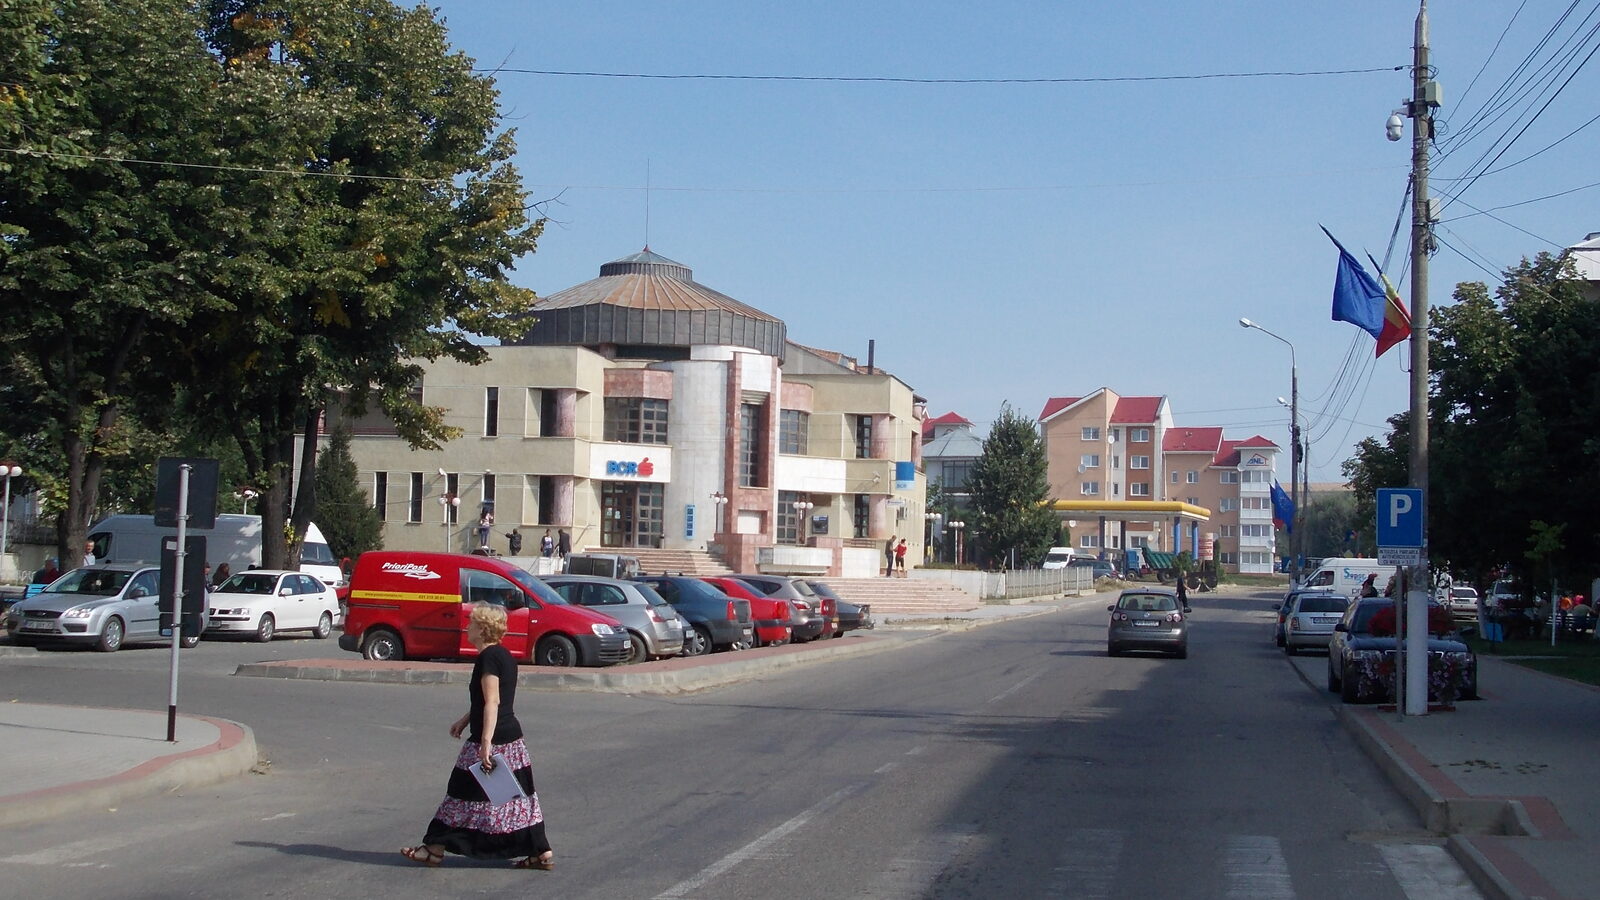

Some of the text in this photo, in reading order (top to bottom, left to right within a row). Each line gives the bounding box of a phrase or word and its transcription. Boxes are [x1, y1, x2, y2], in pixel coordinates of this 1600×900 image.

[606, 460, 637, 477] BCR
[1390, 493, 1412, 527] P
[381, 562, 428, 572] PrioriPost
